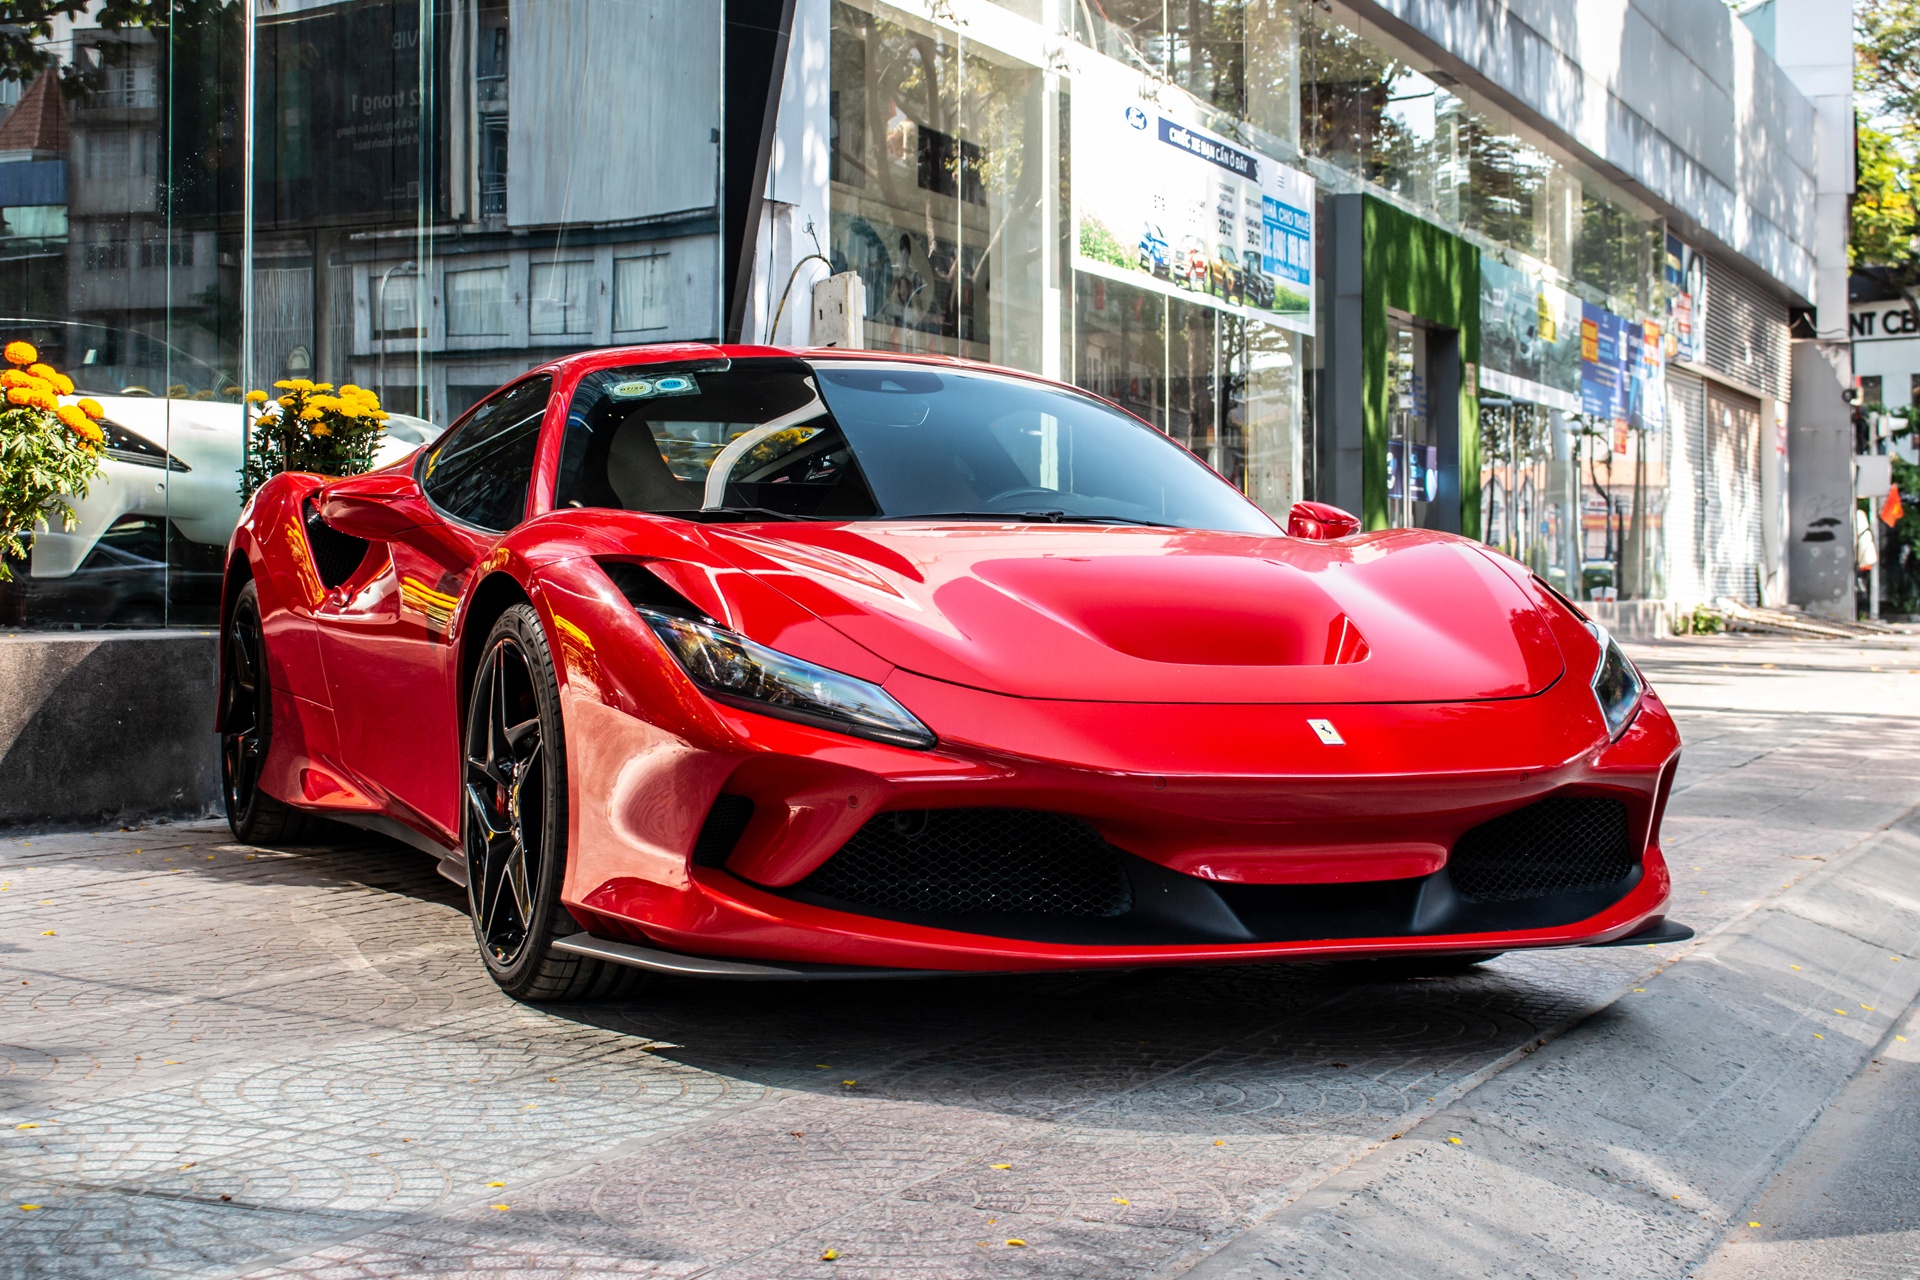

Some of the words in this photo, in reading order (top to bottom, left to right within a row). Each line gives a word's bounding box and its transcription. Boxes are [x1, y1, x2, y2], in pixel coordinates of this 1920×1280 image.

[1278, 207, 1293, 226] CHO
[1294, 212, 1309, 233] THUÊ
[525, 637, 535, 648] P
